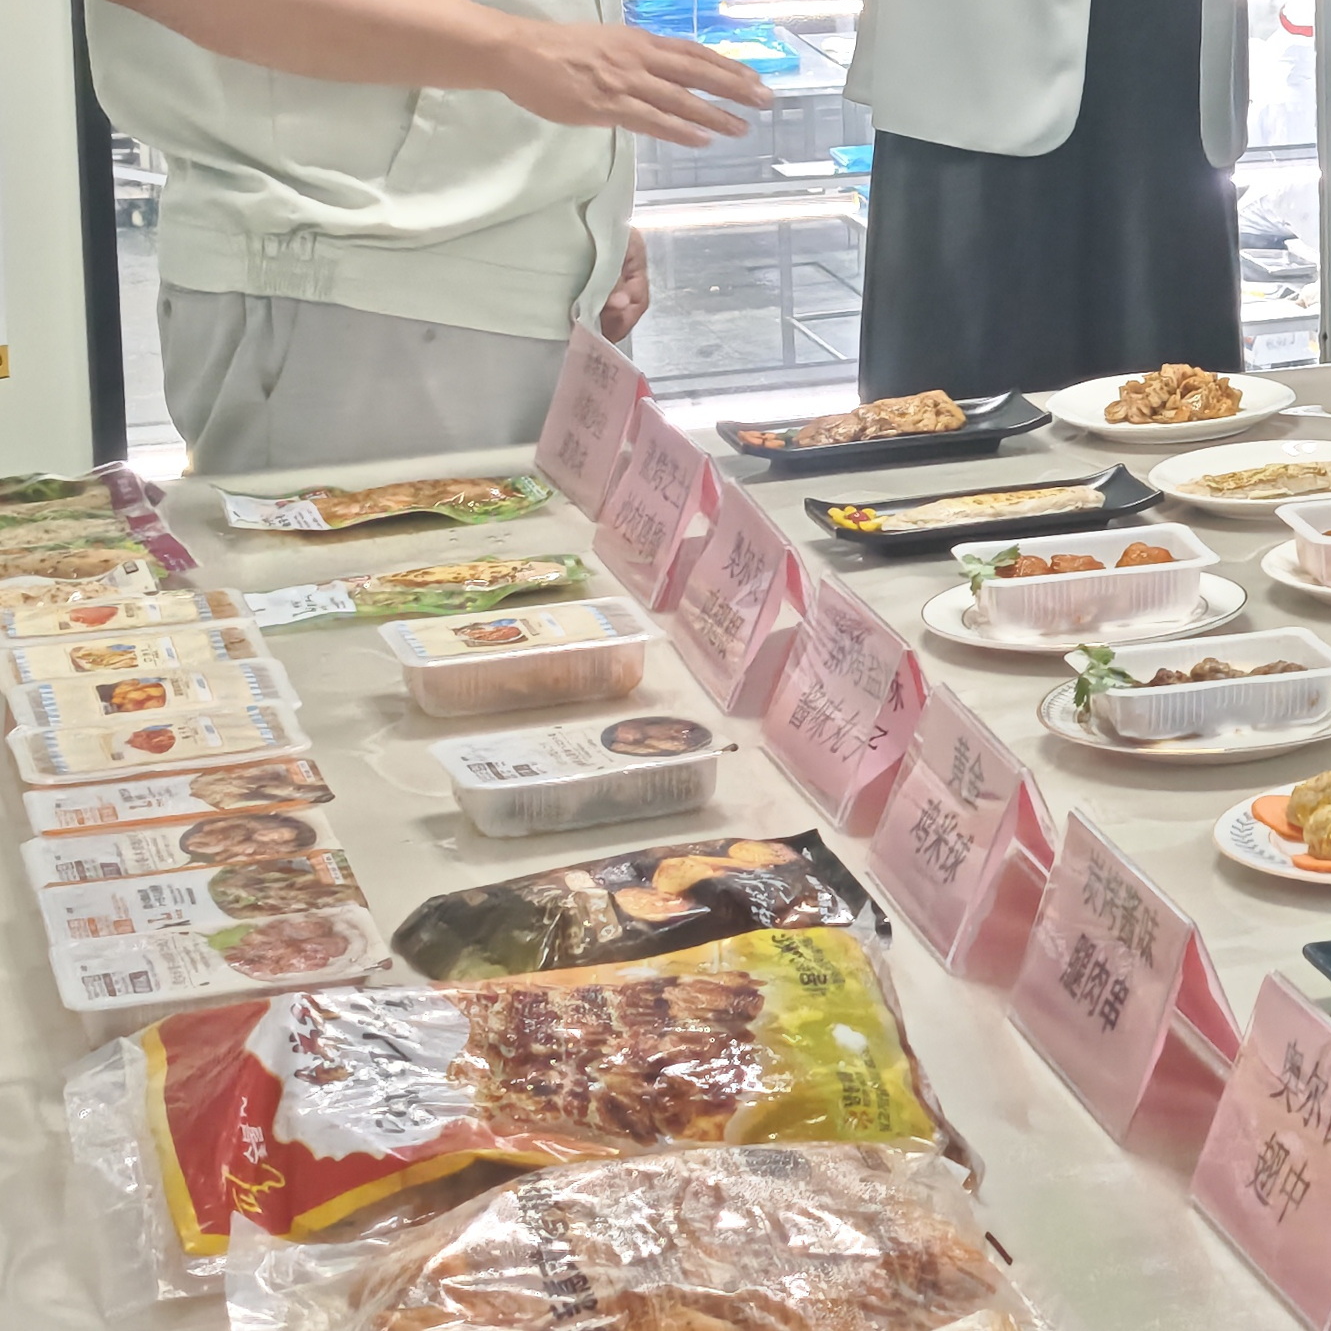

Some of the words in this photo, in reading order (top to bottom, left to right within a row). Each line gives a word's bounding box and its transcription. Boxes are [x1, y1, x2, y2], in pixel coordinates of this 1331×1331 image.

[948, 736, 985, 811] 黄金
[909, 798, 976, 885] 鸡米球
[1244, 1130, 1312, 1225] 翅中
